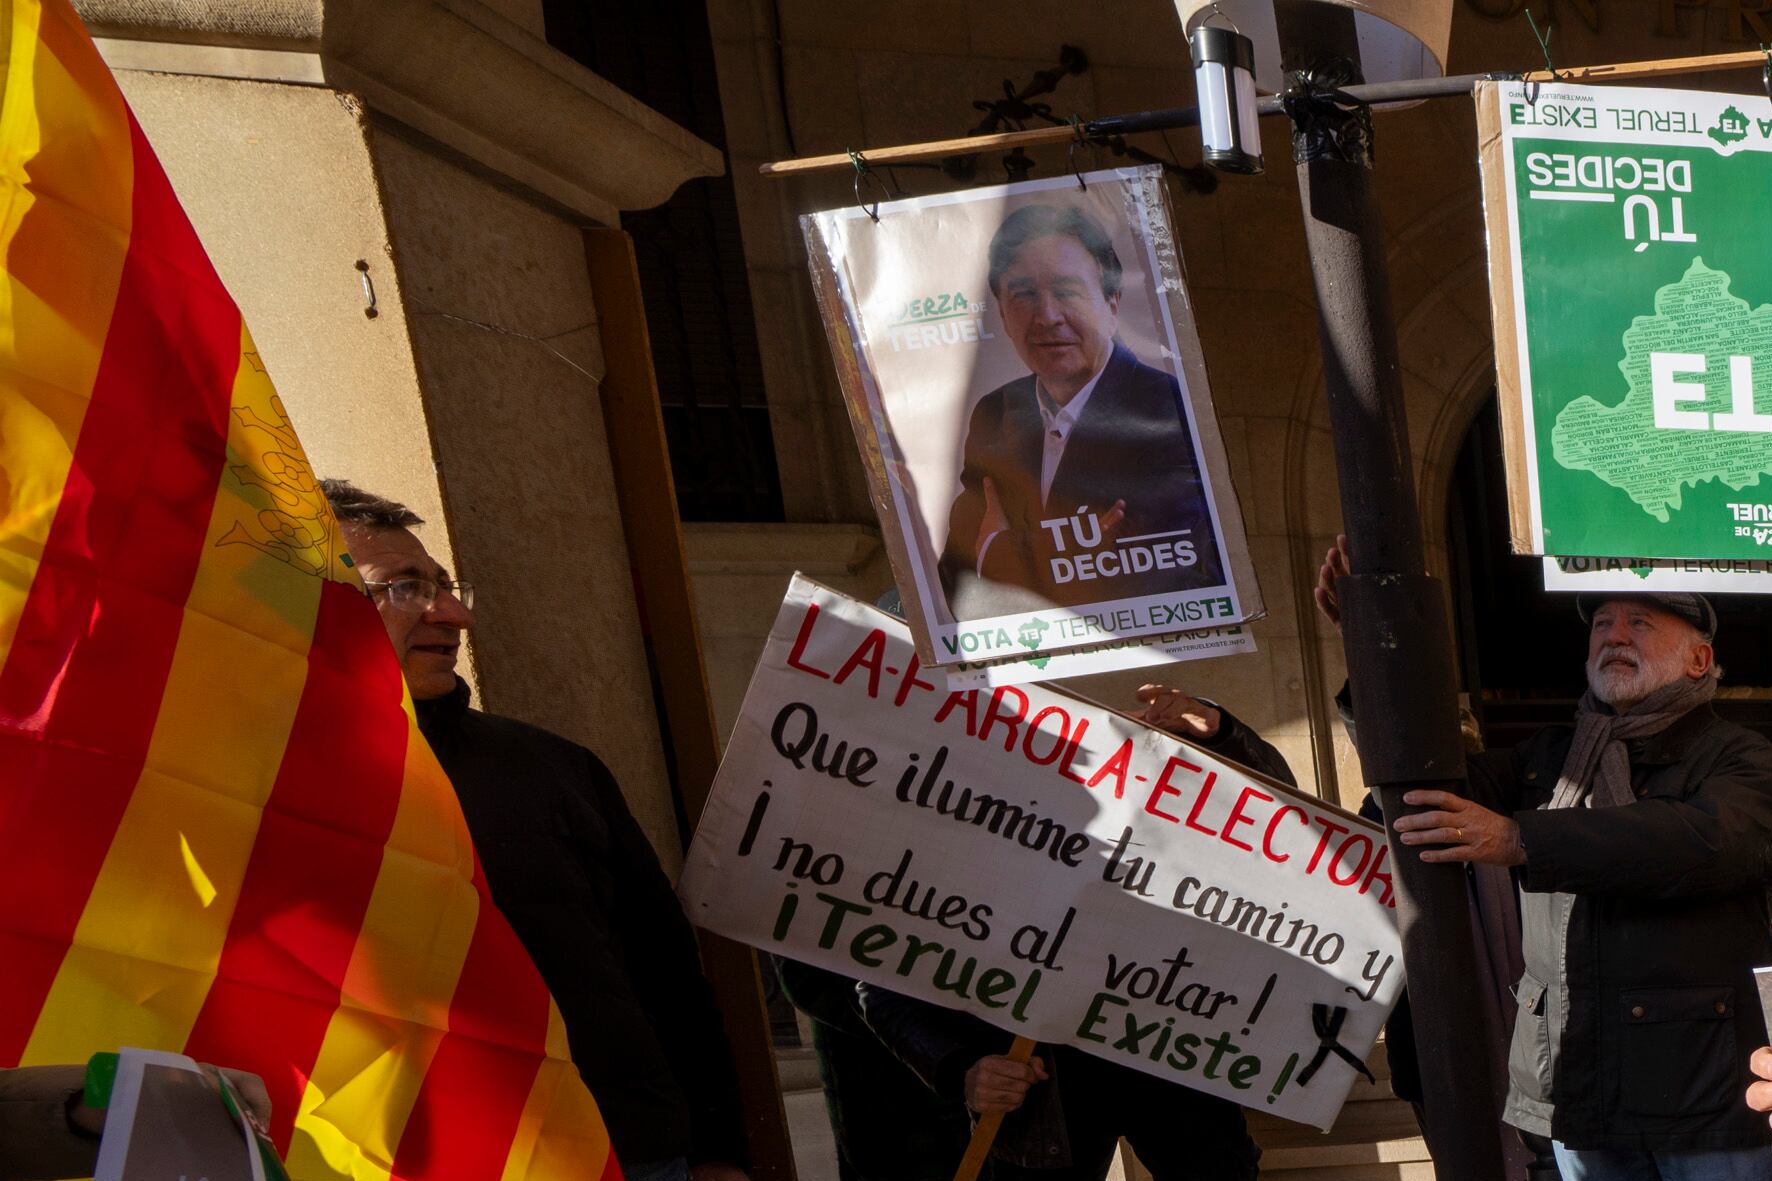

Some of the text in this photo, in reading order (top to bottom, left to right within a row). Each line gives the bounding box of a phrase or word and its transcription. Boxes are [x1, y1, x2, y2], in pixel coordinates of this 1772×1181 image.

[1510, 103, 1597, 128] EXISTE
[1607, 108, 1704, 134] TERUEL
[1527, 152, 1693, 192] DECIDES
[1624, 195, 1698, 253] TÚ
[1692, 291, 1721, 300] ALLEPUZ
[1685, 301, 1712, 309] ABABUJ
[1669, 312, 1699, 321] ALCAINE
[1676, 315, 1727, 326] VALJUNQUERA
[1715, 319, 1750, 328] ABEJUELA
[888, 318, 994, 353] TERUEL
[1672, 326, 1701, 335] ALCAÑIZ
[1730, 327, 1759, 336] BECEITE
[1676, 335, 1703, 343] MARTÍN
[1718, 337, 1750, 346] CALANDA
[1682, 400, 1721, 409] BARRACHINA
[1609, 413, 1642, 422] ALCORISA
[1596, 424, 1638, 434] MONTALBÁN
[1606, 432, 1649, 442] CAMARILLAS
[1660, 435, 1691, 443] MUNIESA
[1590, 442, 1633, 452] CALAMOCHA
[1640, 445, 1674, 453] ANDORRA
[1696, 439, 1750, 450] TRAMACASTILLA
[1650, 451, 1682, 460] UTRILLAS
[1715, 446, 1752, 456] TERRIENTE
[1588, 452, 1624, 461] ALFAMBRA
[1684, 454, 1708, 462] TERUEL
[1609, 464, 1645, 473] VILLASTAR
[1690, 460, 1734, 471] CASTELLOTE
[1727, 462, 1766, 472] FORTANETE
[1630, 470, 1671, 480] CANTAVIEJA
[1040, 505, 1102, 552] TÚ
[1735, 526, 1751, 537] DE
[1050, 540, 1198, 584] DECIDES
[942, 628, 1012, 655] VOTA
[1054, 610, 1146, 639] TERUEL
[1150, 596, 1236, 626] EXISTE
[1165, 639, 1246, 655] WWW.TERUELEXISTE.INFO
[787, 603, 1396, 907] LA-FAROLA-ELECTOR
[770, 702, 1394, 1001] Que ilumine tu camino y
[863, 849, 993, 941] dues
[1010, 906, 1077, 971] al
